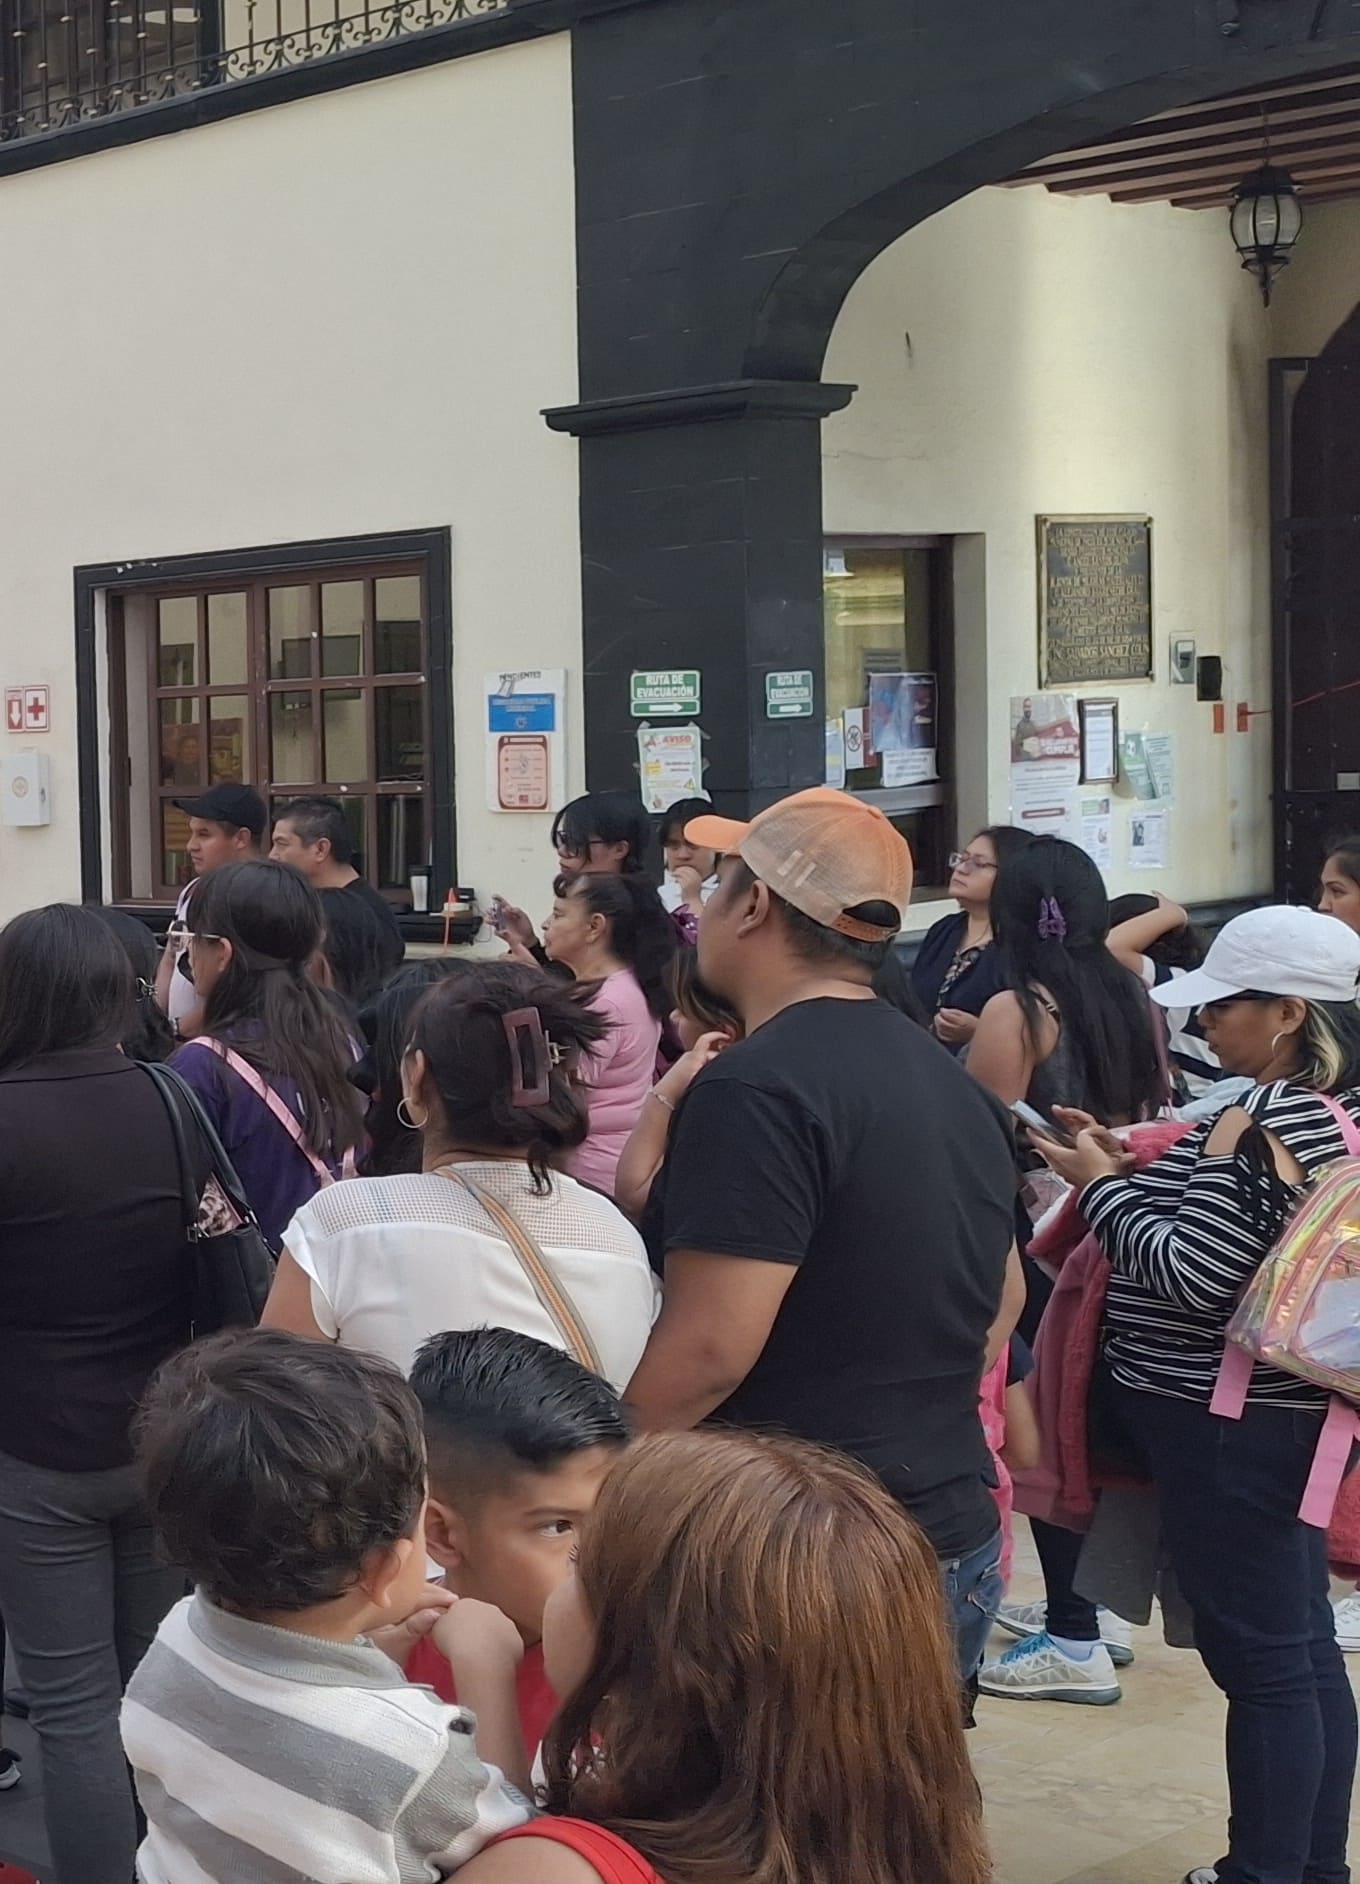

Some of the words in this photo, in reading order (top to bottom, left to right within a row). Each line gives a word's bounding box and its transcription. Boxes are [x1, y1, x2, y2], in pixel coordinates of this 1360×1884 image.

[645, 674, 670, 686] RUTA
[672, 674, 685, 685] DE
[776, 675, 793, 686] RUTA
[794, 674, 803, 685] DE
[636, 685, 694, 698] EVACUACIÓN
[662, 734, 692, 744] AVISO
